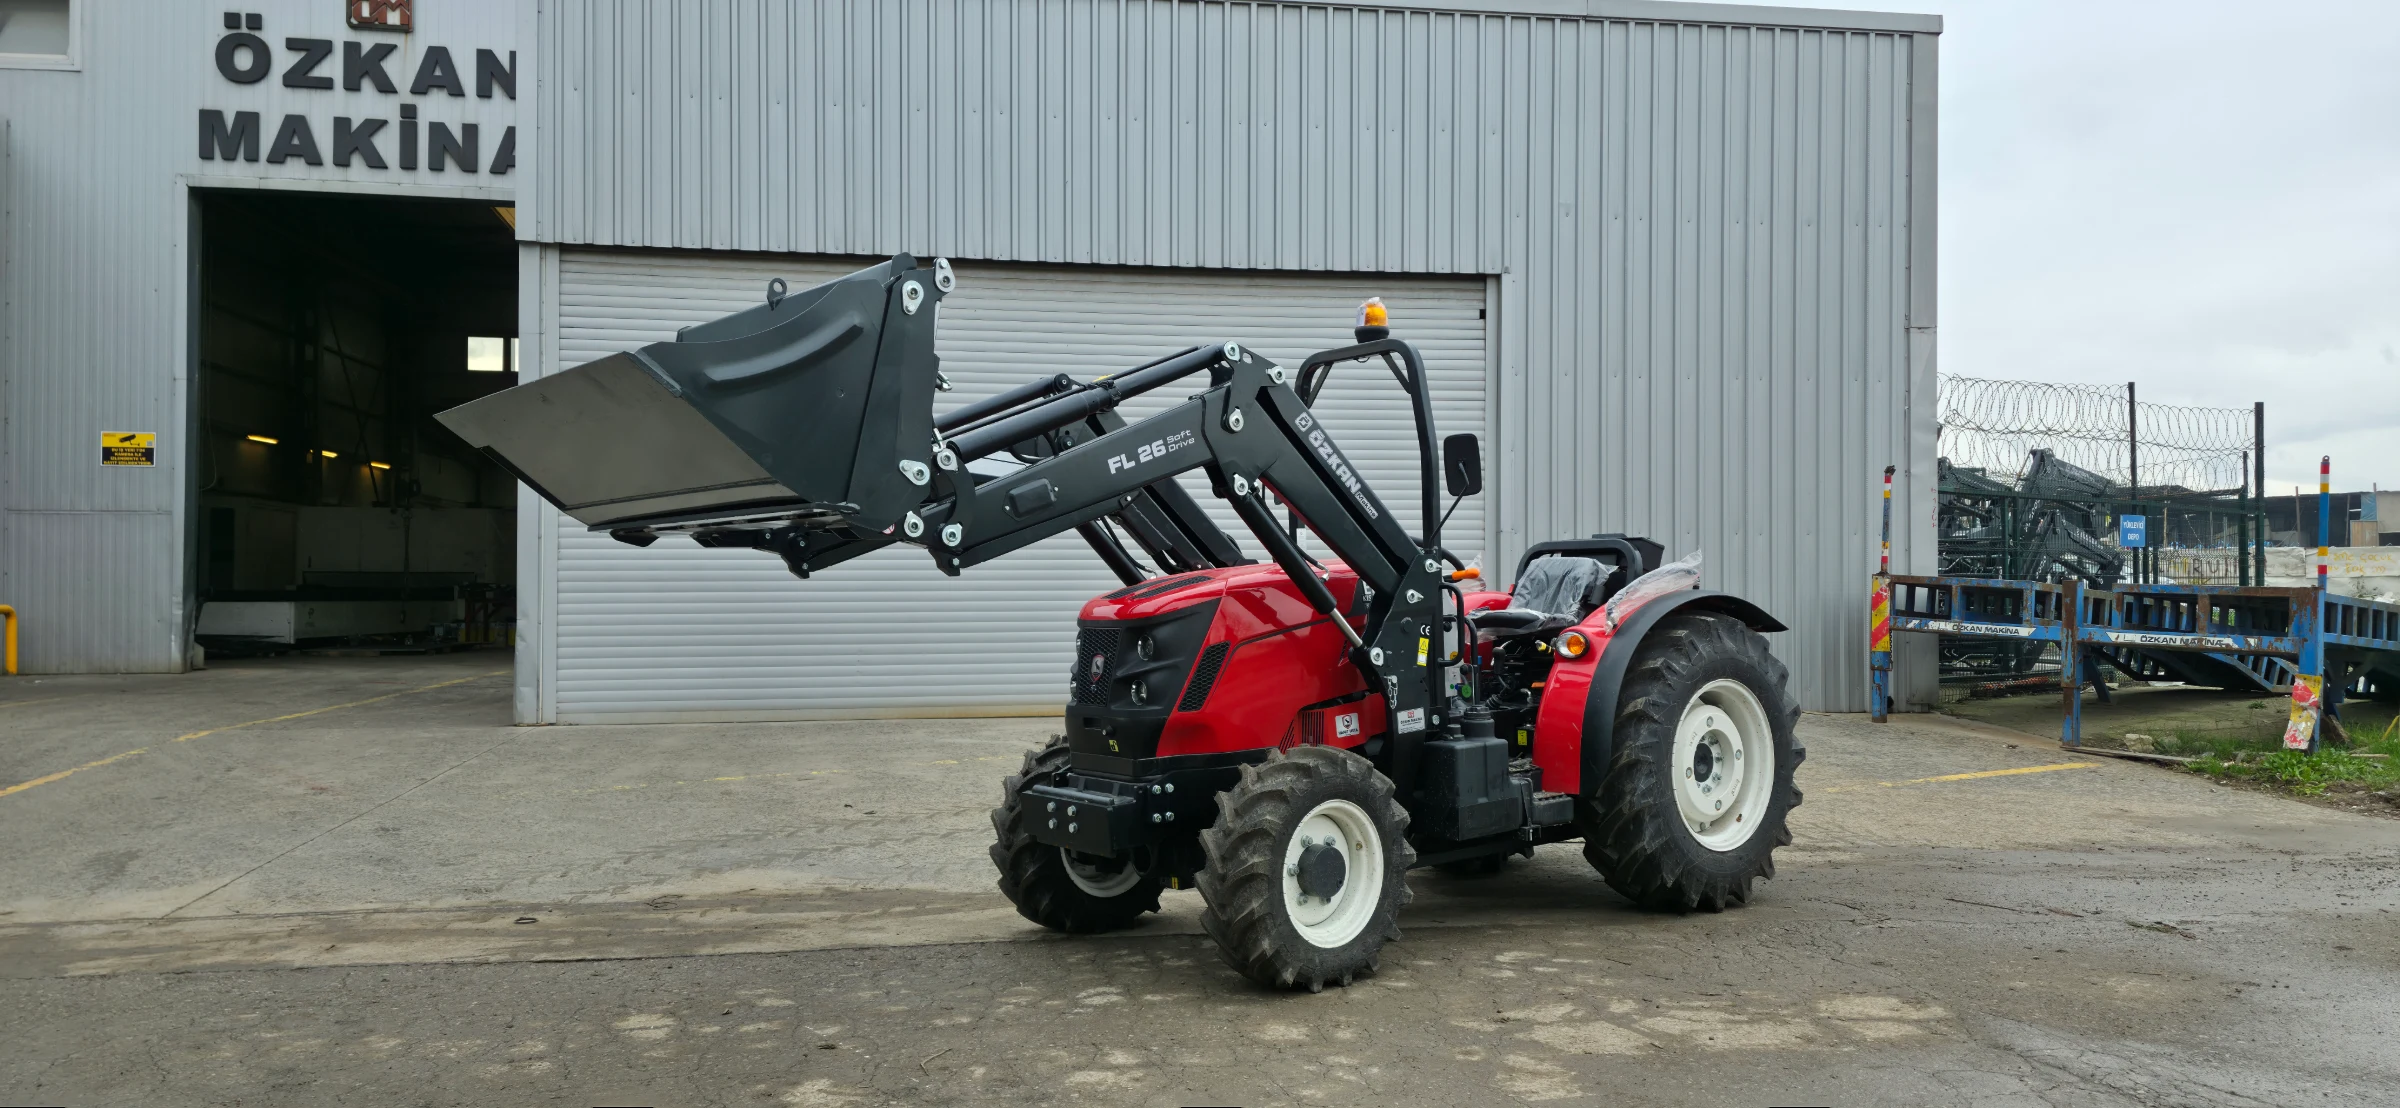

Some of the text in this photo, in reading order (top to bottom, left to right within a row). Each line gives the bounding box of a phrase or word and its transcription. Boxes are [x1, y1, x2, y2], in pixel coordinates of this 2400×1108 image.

[215, 12, 516, 100] ÖZKAN
[1166, 430, 1191, 444] Soft
[1168, 437, 1195, 452] Drive
[1107, 439, 1167, 475] FL 26
[1308, 429, 1361, 494] ÖZKAN
[2127, 533, 2140, 541] DEPO
[1420, 624, 1431, 636] CE
[1952, 624, 2020, 635] ÖZKAN MAKİNA
[2140, 634, 2177, 644] ÖZKAN
